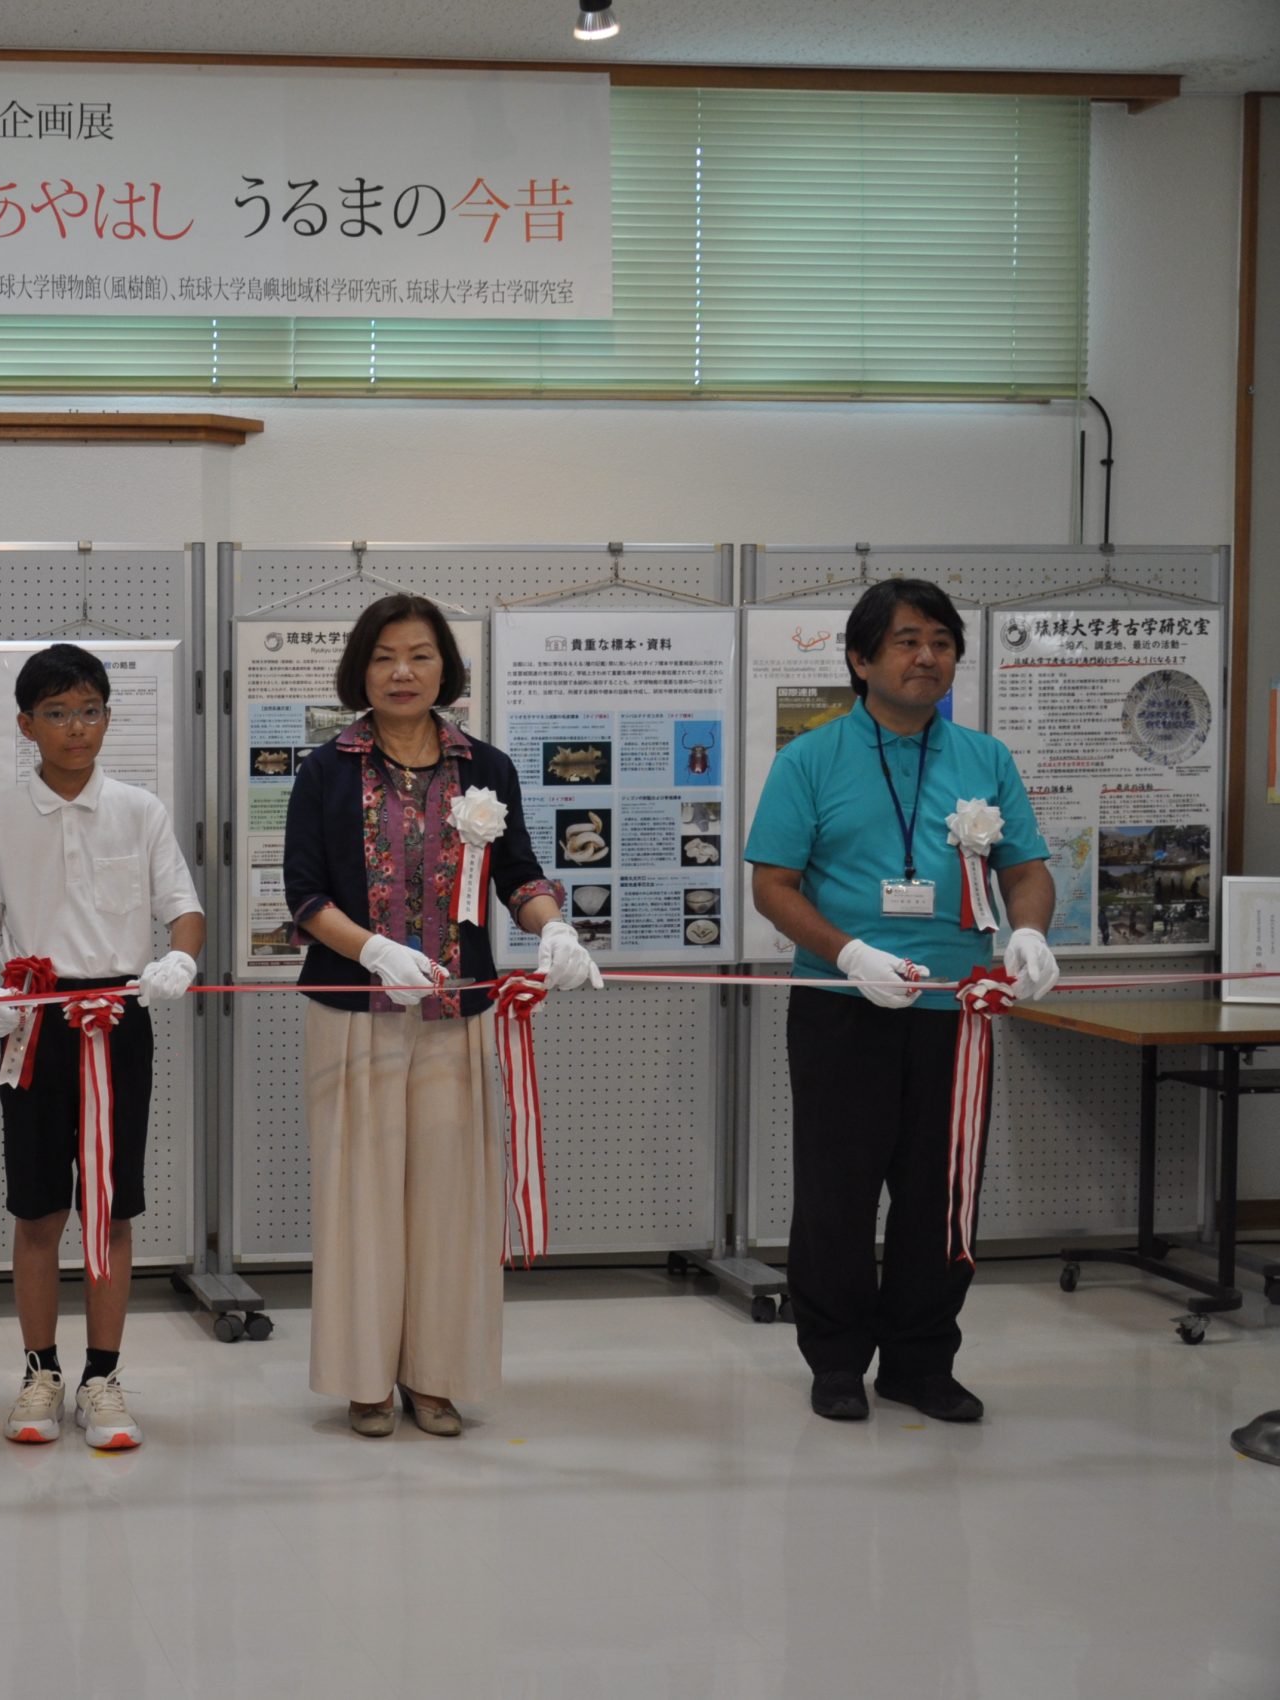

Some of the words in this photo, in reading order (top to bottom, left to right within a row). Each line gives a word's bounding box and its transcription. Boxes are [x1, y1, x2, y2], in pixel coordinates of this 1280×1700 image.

[234, 175, 574, 243] うるまの今昔
[1035, 617, 1210, 639] 琉球大学考古学研究室
[571, 637, 672, 652] 貴重な標本・資料
